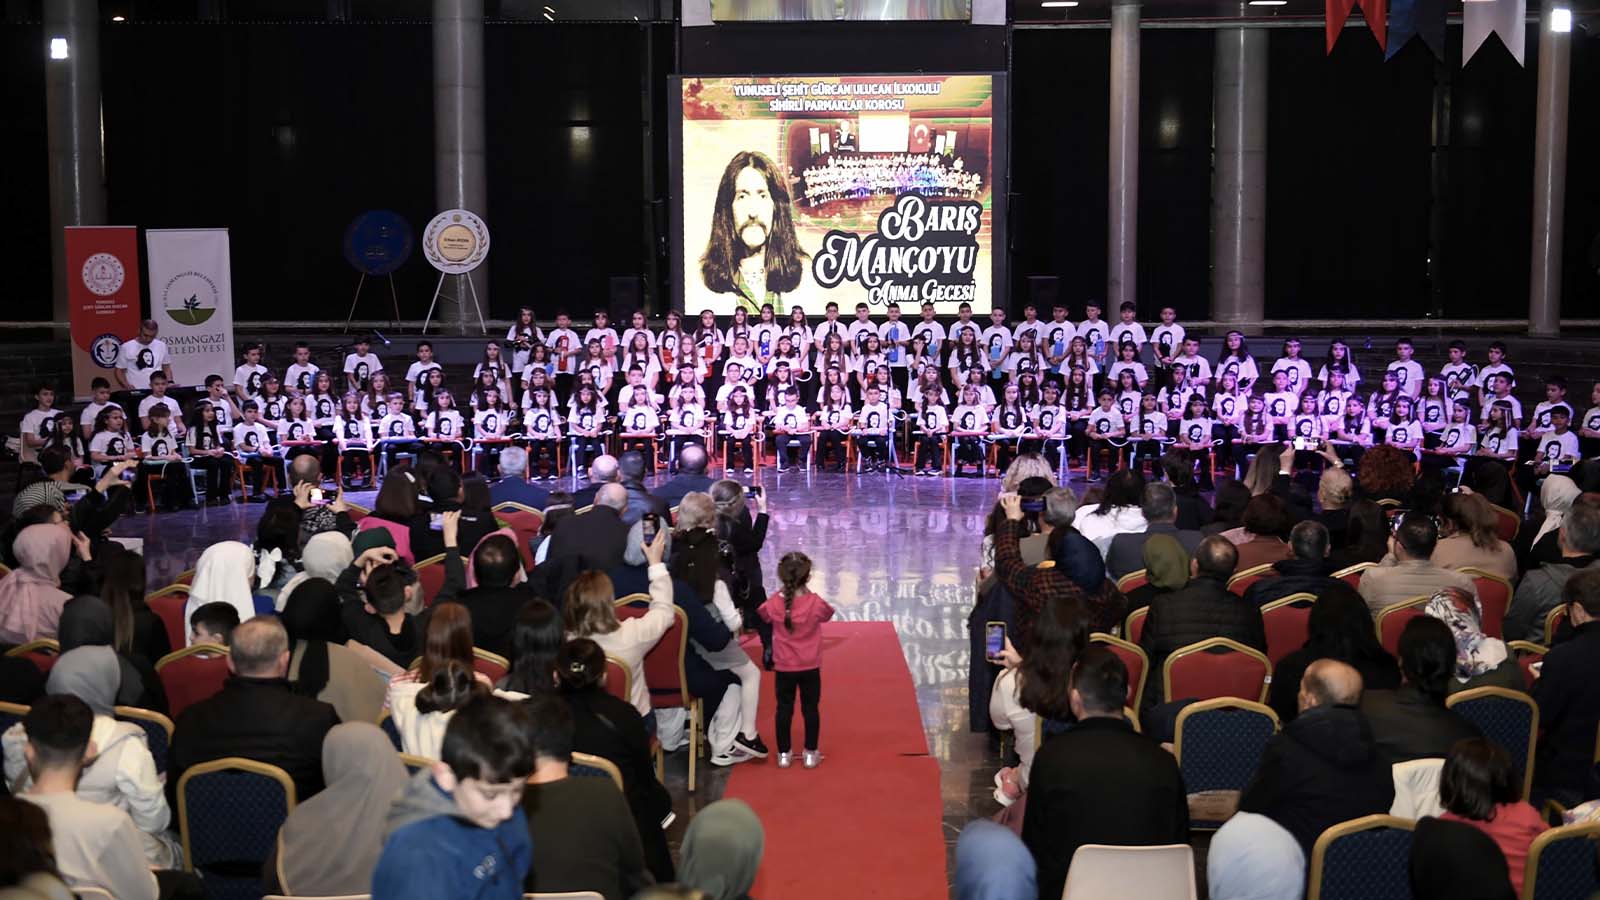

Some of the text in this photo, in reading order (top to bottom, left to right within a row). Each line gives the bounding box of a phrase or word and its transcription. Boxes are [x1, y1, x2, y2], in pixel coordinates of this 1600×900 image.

[734, 81, 941, 98] YUNUSELİ ŞEHİT GÜRCAN ULUCAN İLKOKULU
[769, 98, 905, 112] SİHİRLİ PARMAKLAR KOROSU
[881, 195, 979, 241] BARIŞ
[815, 234, 975, 286] MANÇO'YU
[167, 344, 225, 355] ELEDİYESİ
